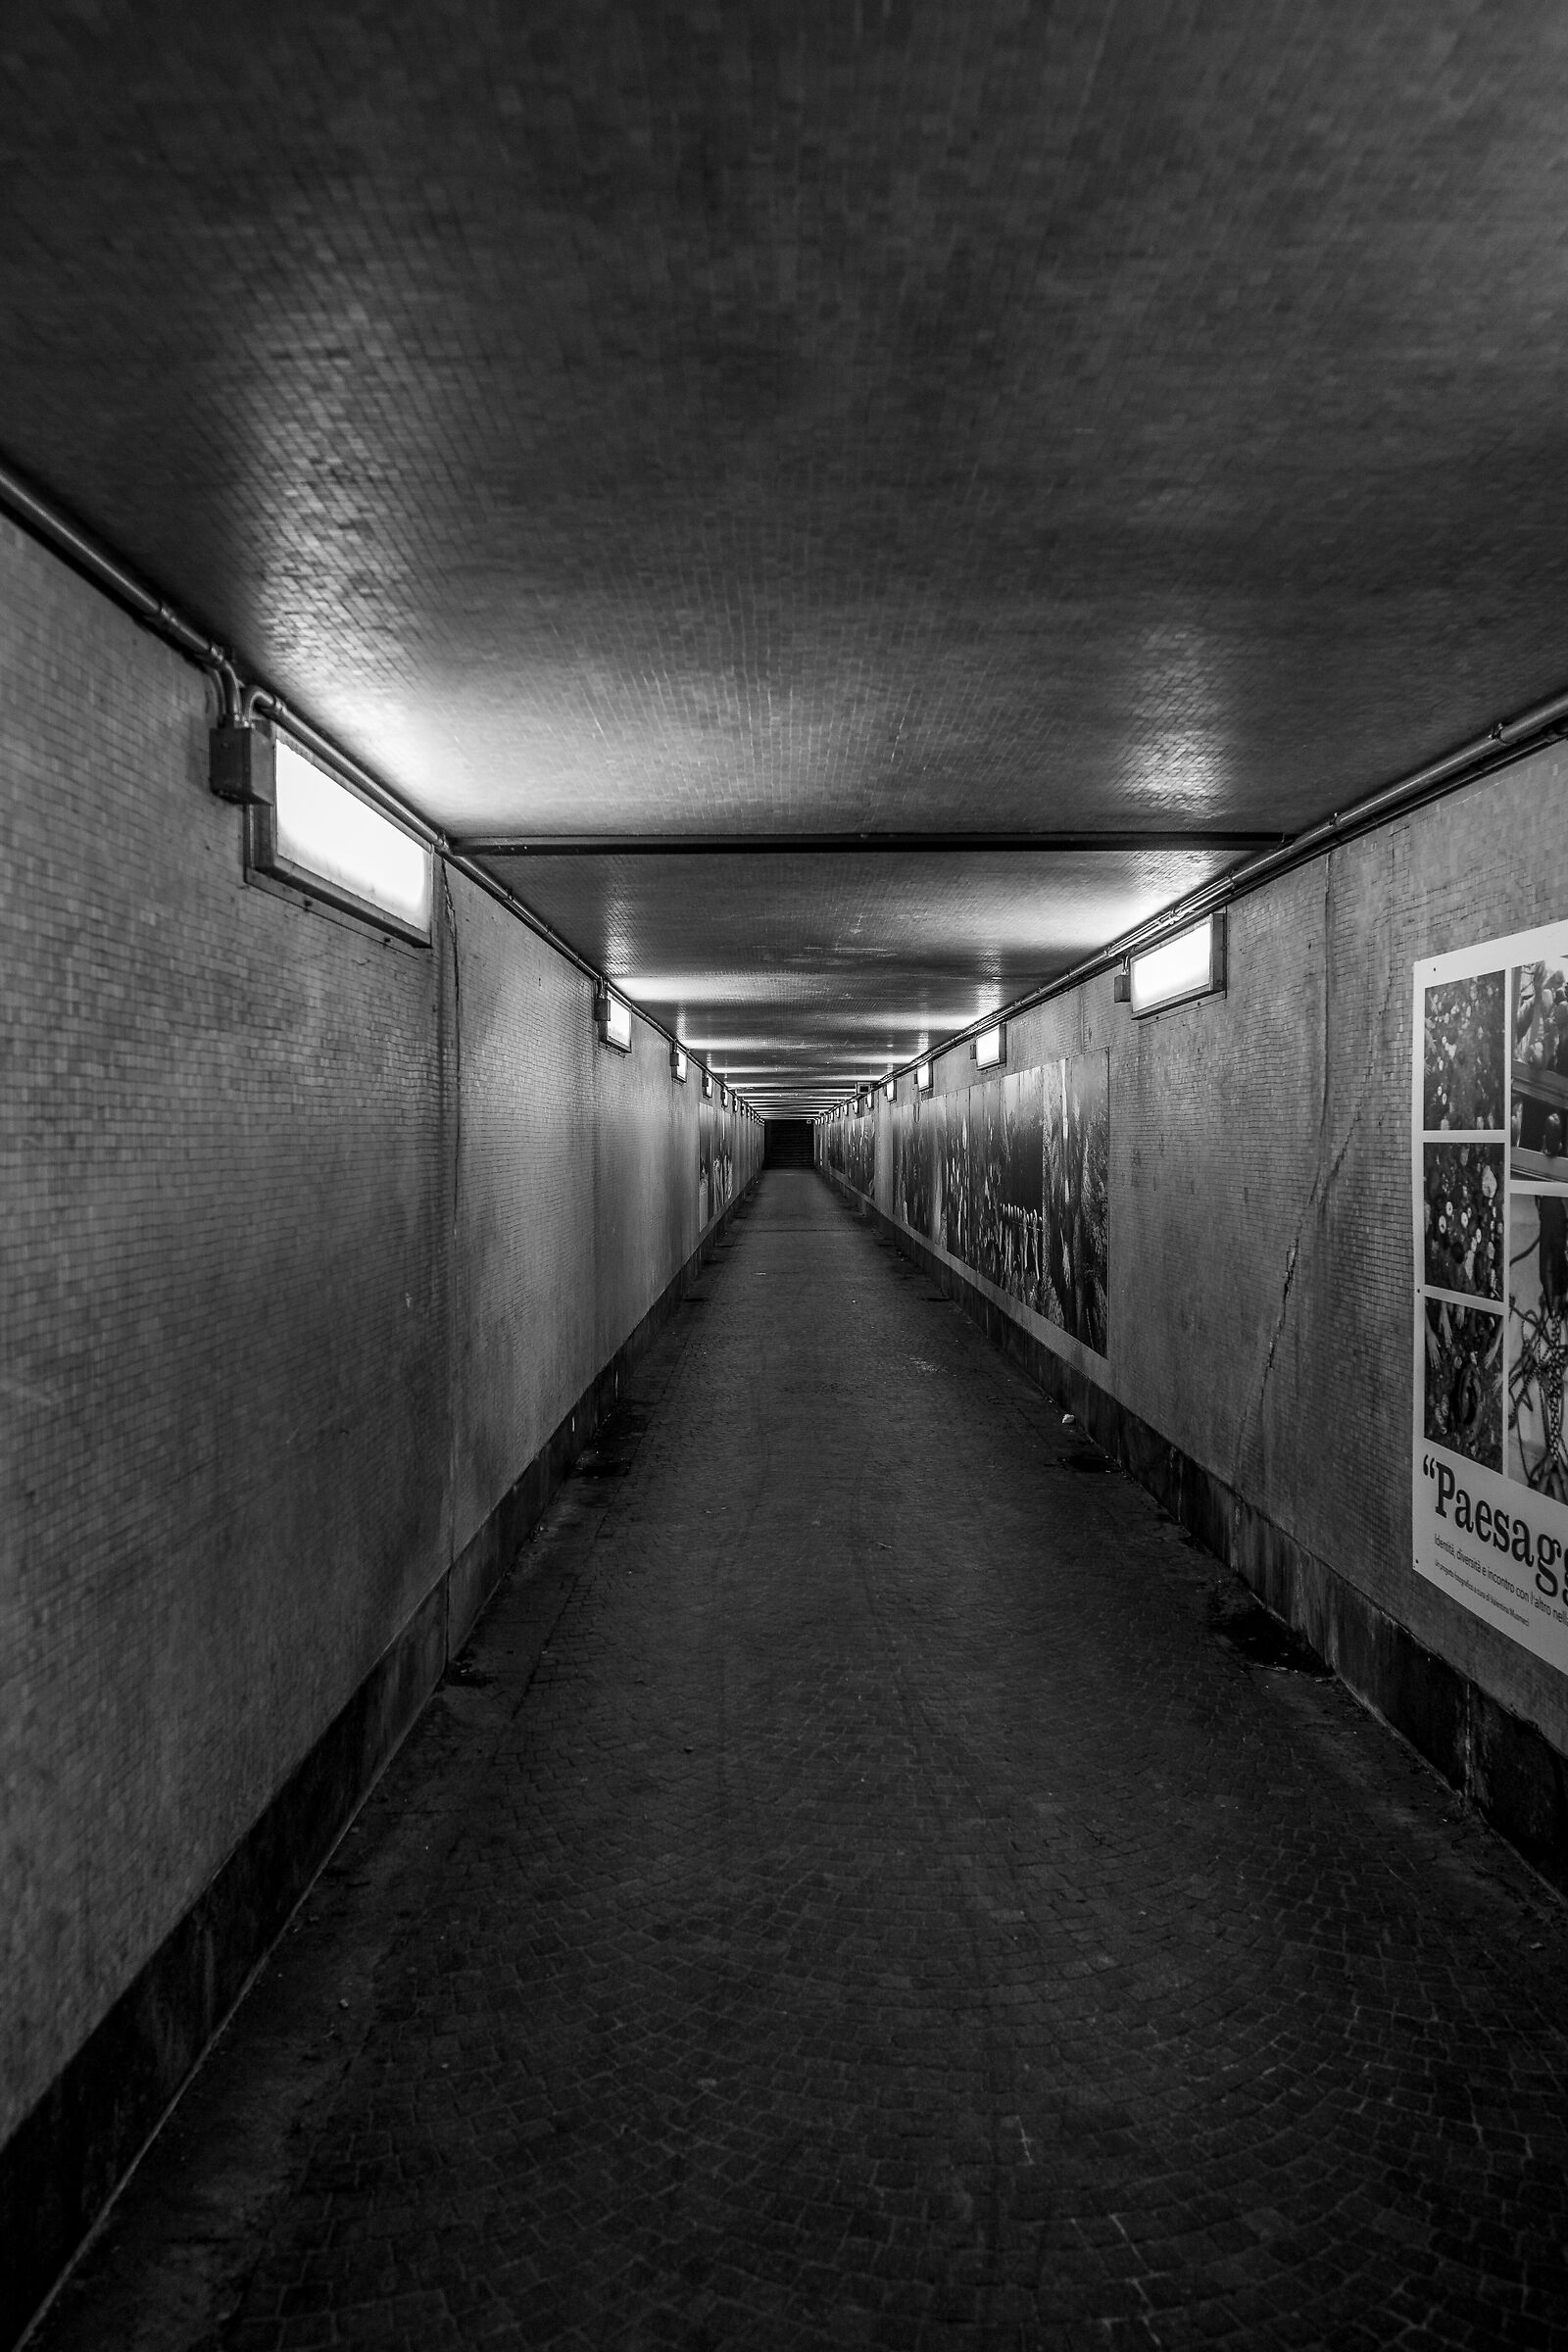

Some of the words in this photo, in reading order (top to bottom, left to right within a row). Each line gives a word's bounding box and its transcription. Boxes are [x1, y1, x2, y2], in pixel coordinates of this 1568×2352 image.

[1423, 1454, 1568, 1609] “Paesag
[1482, 1567, 1487, 1576] e
[1488, 1567, 1515, 1593] incontro
[1515, 1588, 1530, 1602] con
[1552, 1609, 1568, 1628] nell
